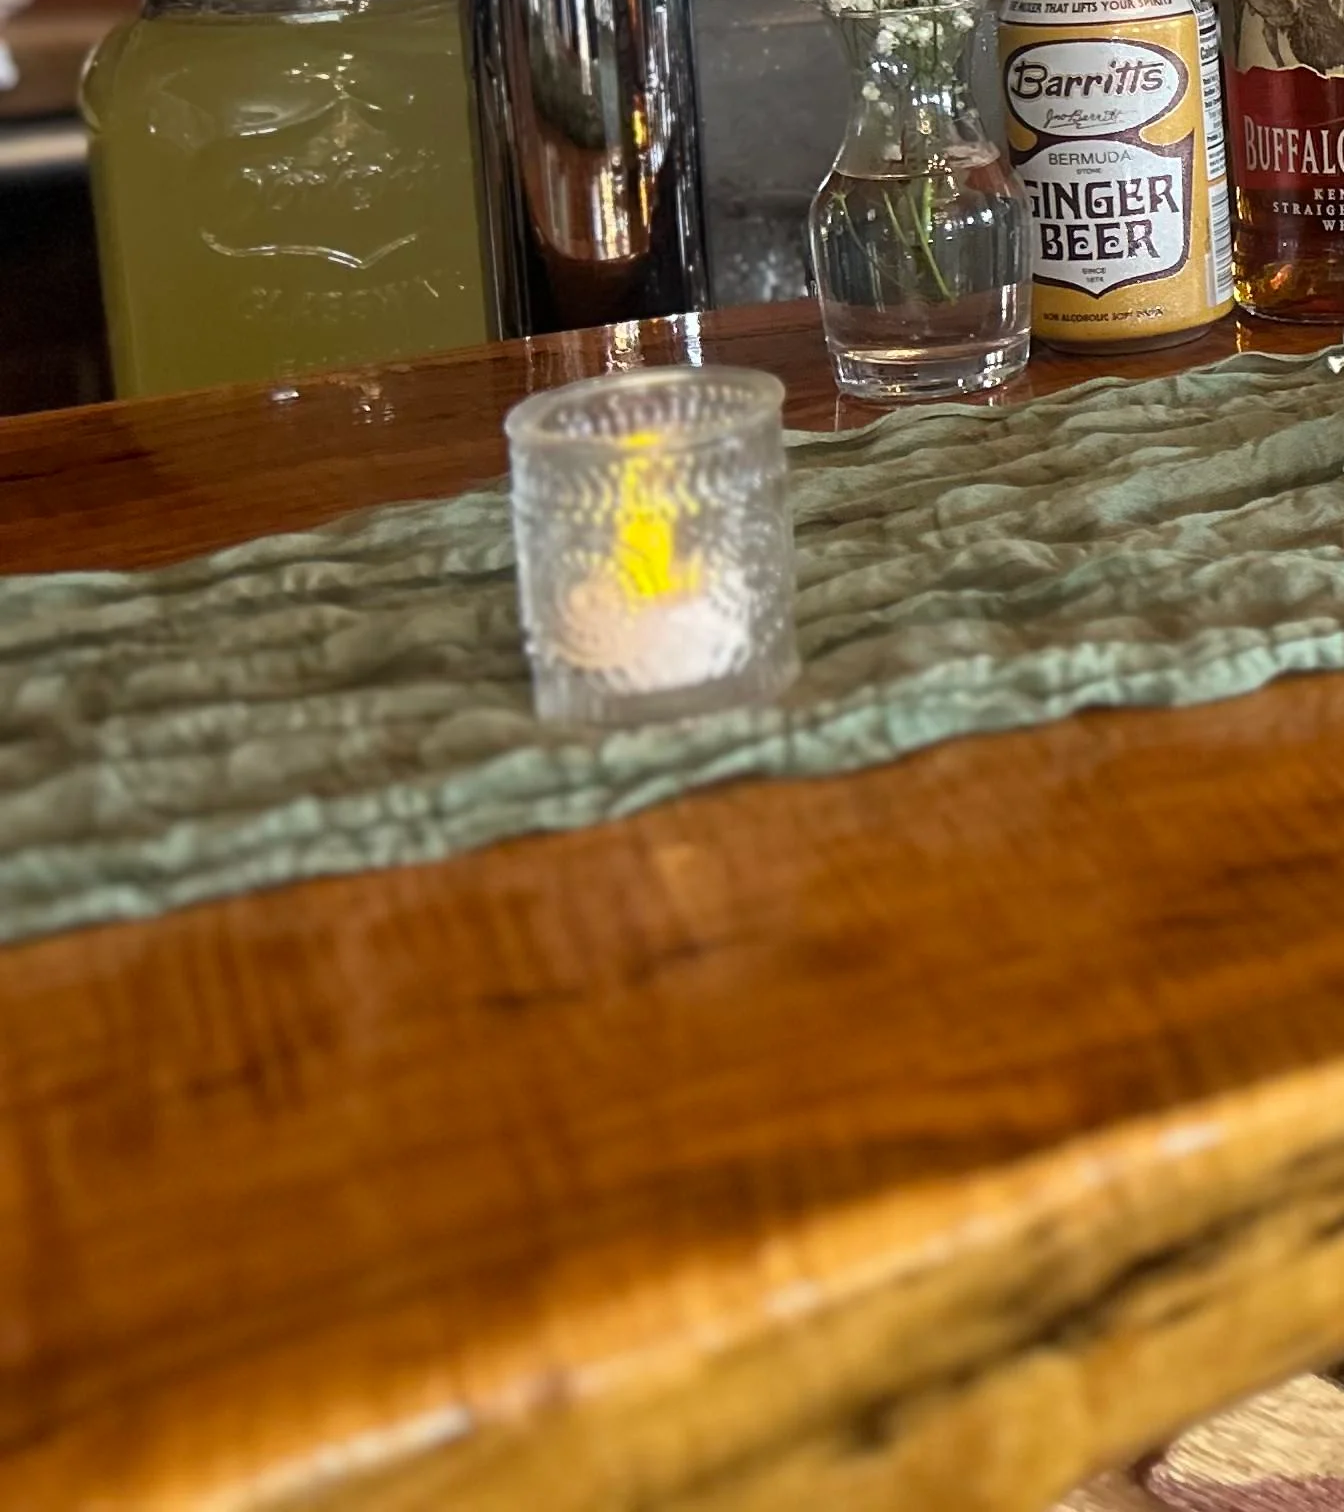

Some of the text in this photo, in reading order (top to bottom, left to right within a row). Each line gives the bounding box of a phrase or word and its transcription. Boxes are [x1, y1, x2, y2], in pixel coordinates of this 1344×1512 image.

[1044, 2, 1070, 14] THAT
[1071, 1, 1098, 14] LIFTS
[1101, 0, 1136, 12] YOUR
[1048, 149, 1134, 166] BERMUDA
[1023, 174, 1180, 220] GINGER
[1040, 219, 1161, 262] BEER
